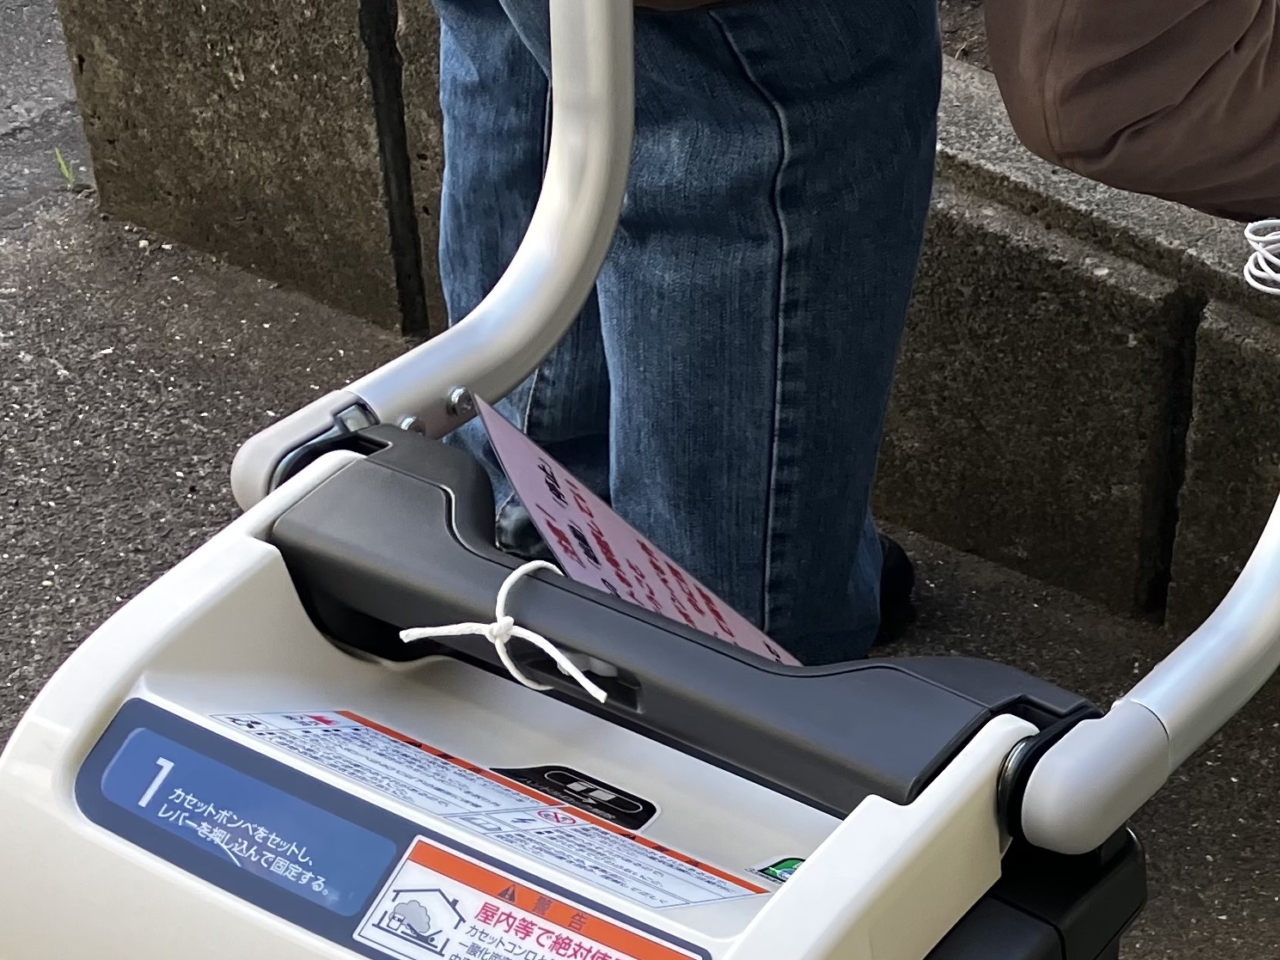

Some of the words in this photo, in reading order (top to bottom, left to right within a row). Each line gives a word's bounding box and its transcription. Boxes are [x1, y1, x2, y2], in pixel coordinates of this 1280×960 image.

[138, 756, 175, 808] 1
[157, 803, 329, 896] レバーを押し込んで固定する。
[168, 788, 313, 866] カセットボンベをセットし、
